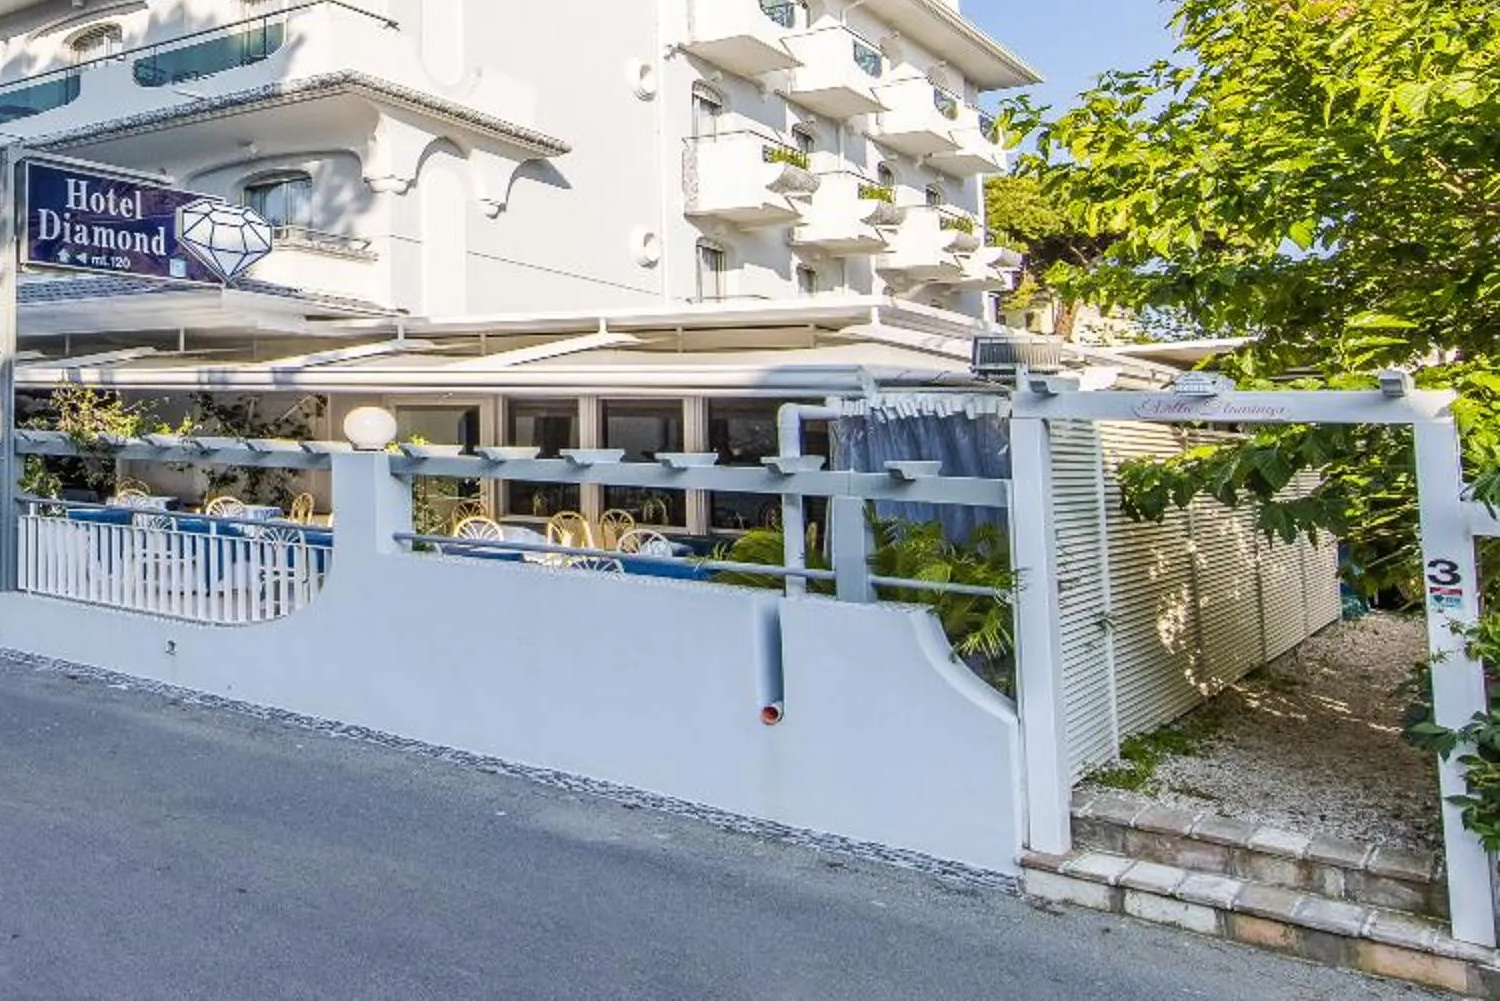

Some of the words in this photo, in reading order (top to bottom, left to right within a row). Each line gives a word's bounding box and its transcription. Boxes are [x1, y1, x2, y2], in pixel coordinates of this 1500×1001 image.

[65, 178, 143, 219] Hotel
[37, 208, 167, 256] Diamond
[1427, 559, 1461, 585] 3
